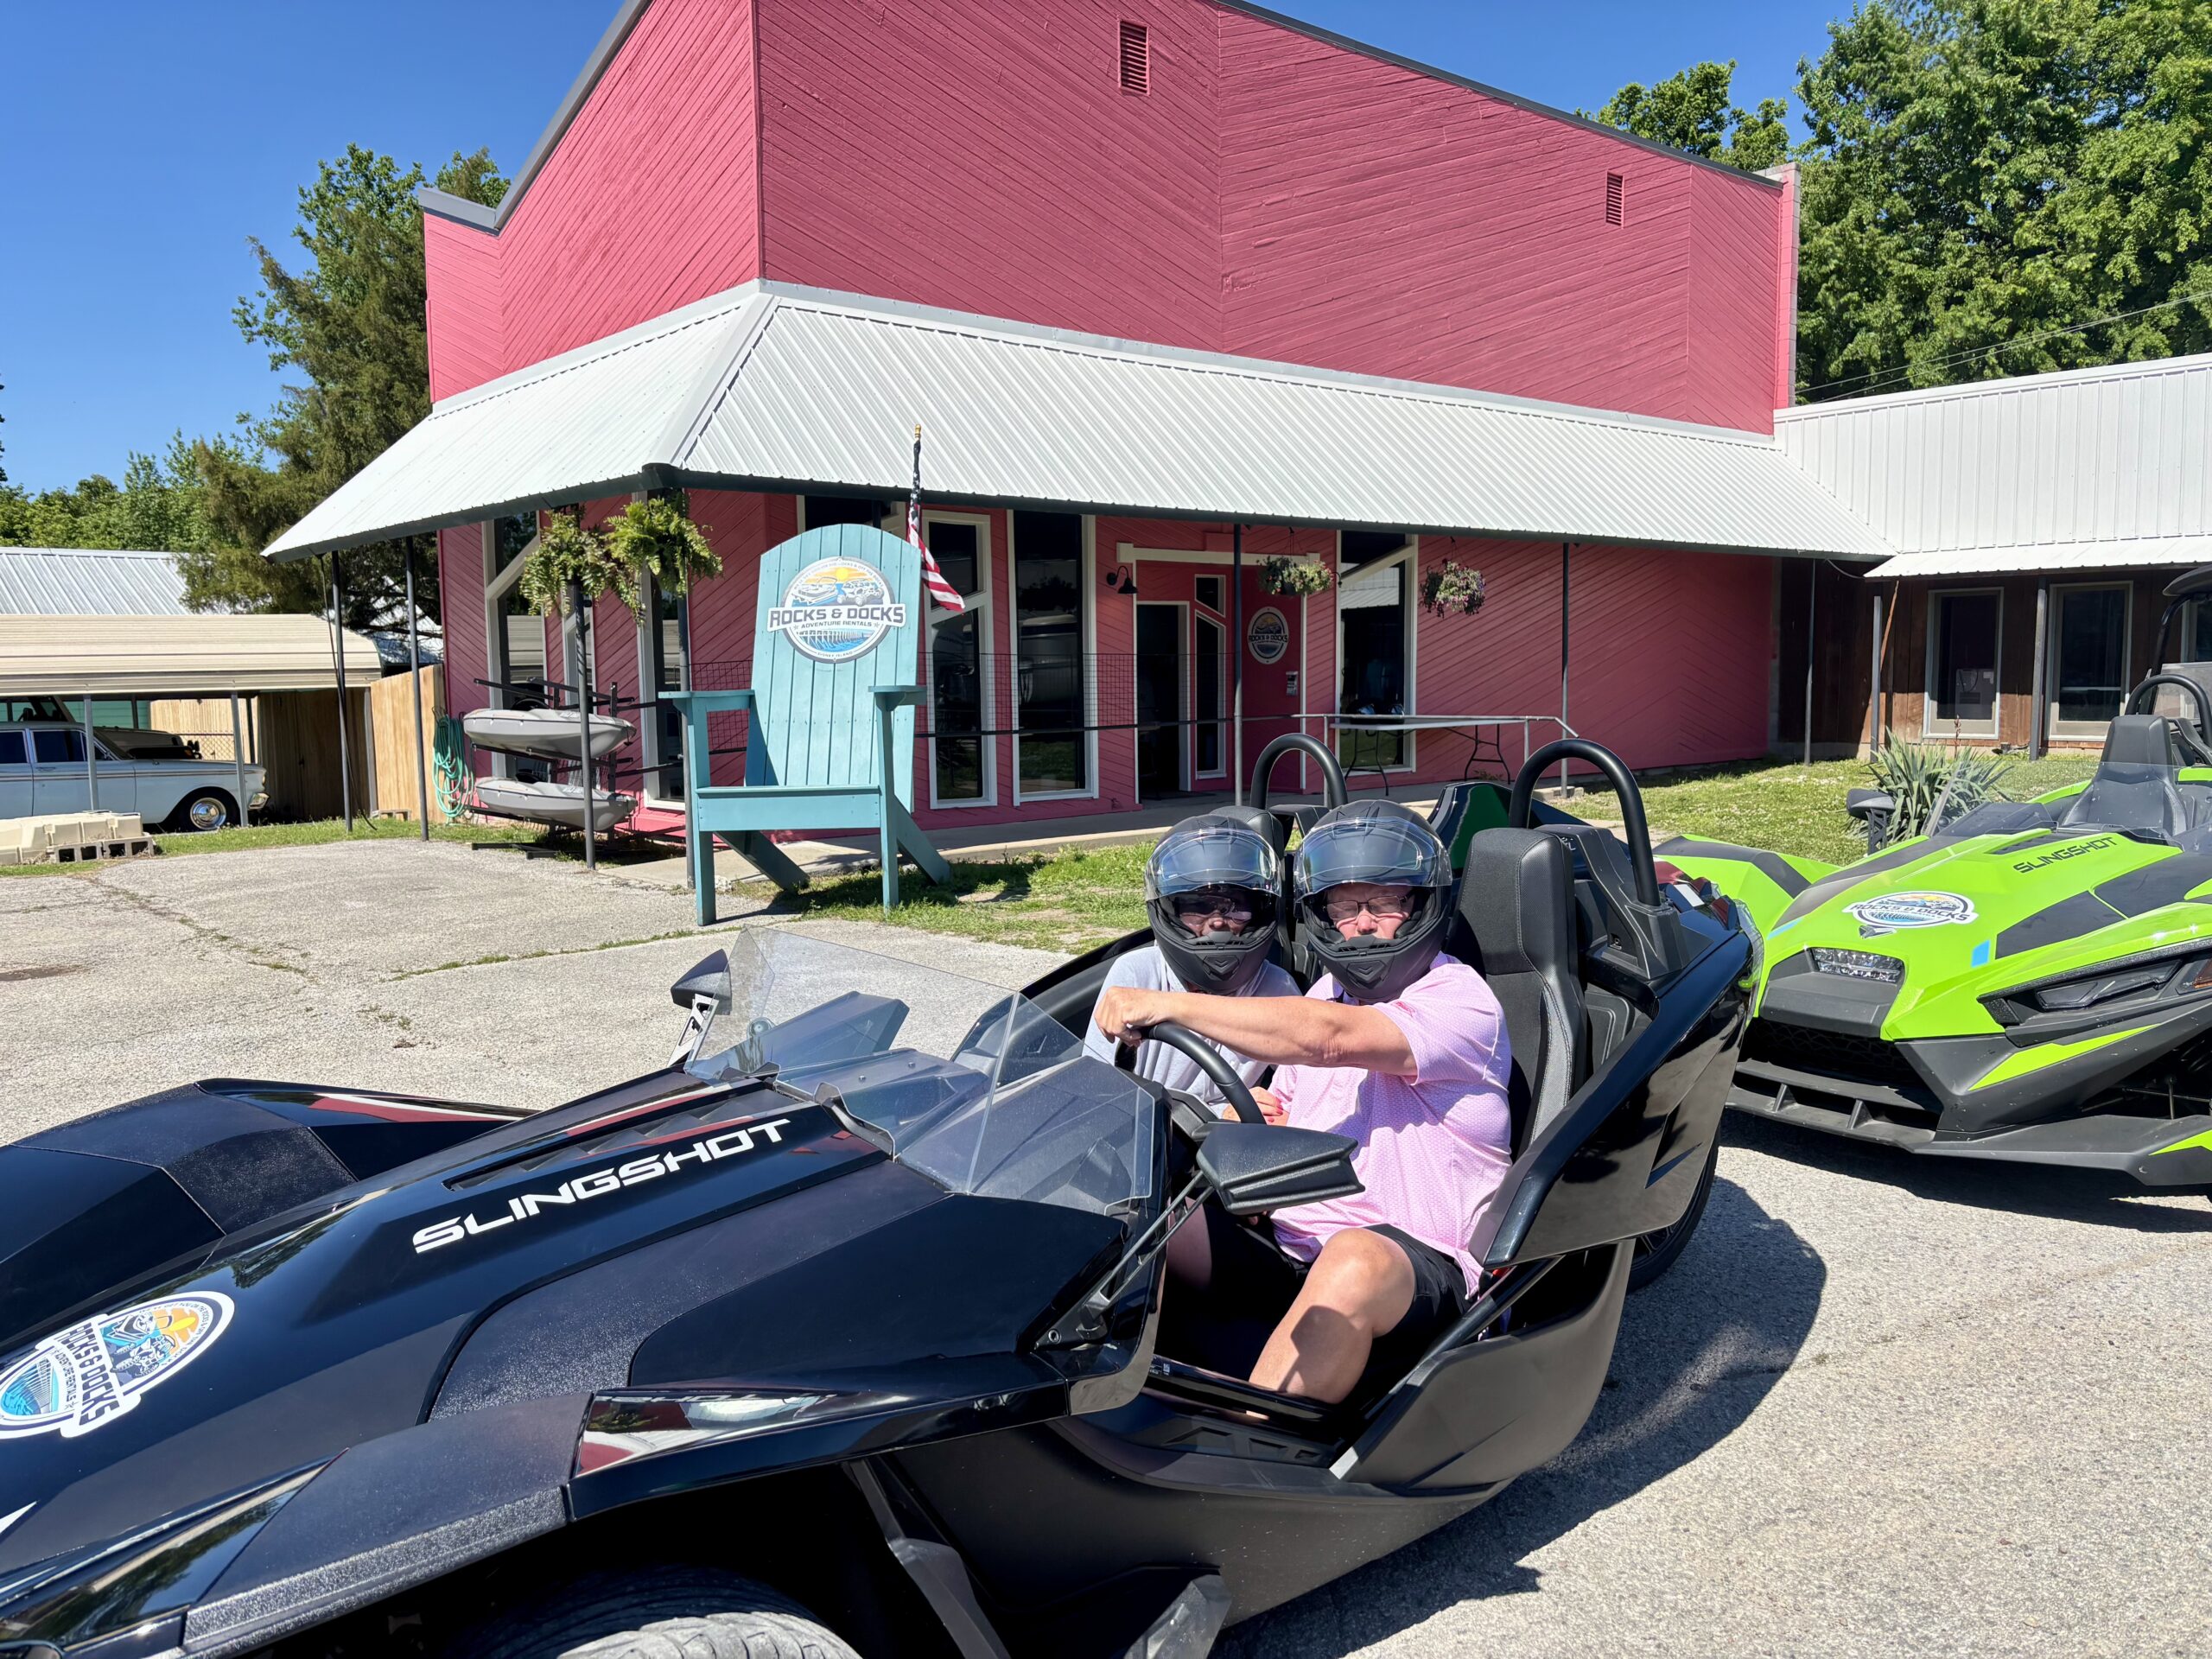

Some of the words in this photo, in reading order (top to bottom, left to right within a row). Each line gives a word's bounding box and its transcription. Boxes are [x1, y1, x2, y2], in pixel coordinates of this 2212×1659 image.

[769, 609, 827, 628] ROCKS
[831, 608, 842, 619] &
[847, 607, 904, 624] DOCKS
[801, 620, 841, 629] ADVENTURE
[2013, 836, 2117, 874] SLINGSHOT
[1917, 908, 1970, 921] DOCKS
[412, 1118, 791, 1254] SLINGSHOT
[54, 1322, 99, 1360] ROCKS
[79, 1354, 103, 1369] &
[79, 1363, 120, 1426] DOCKS
